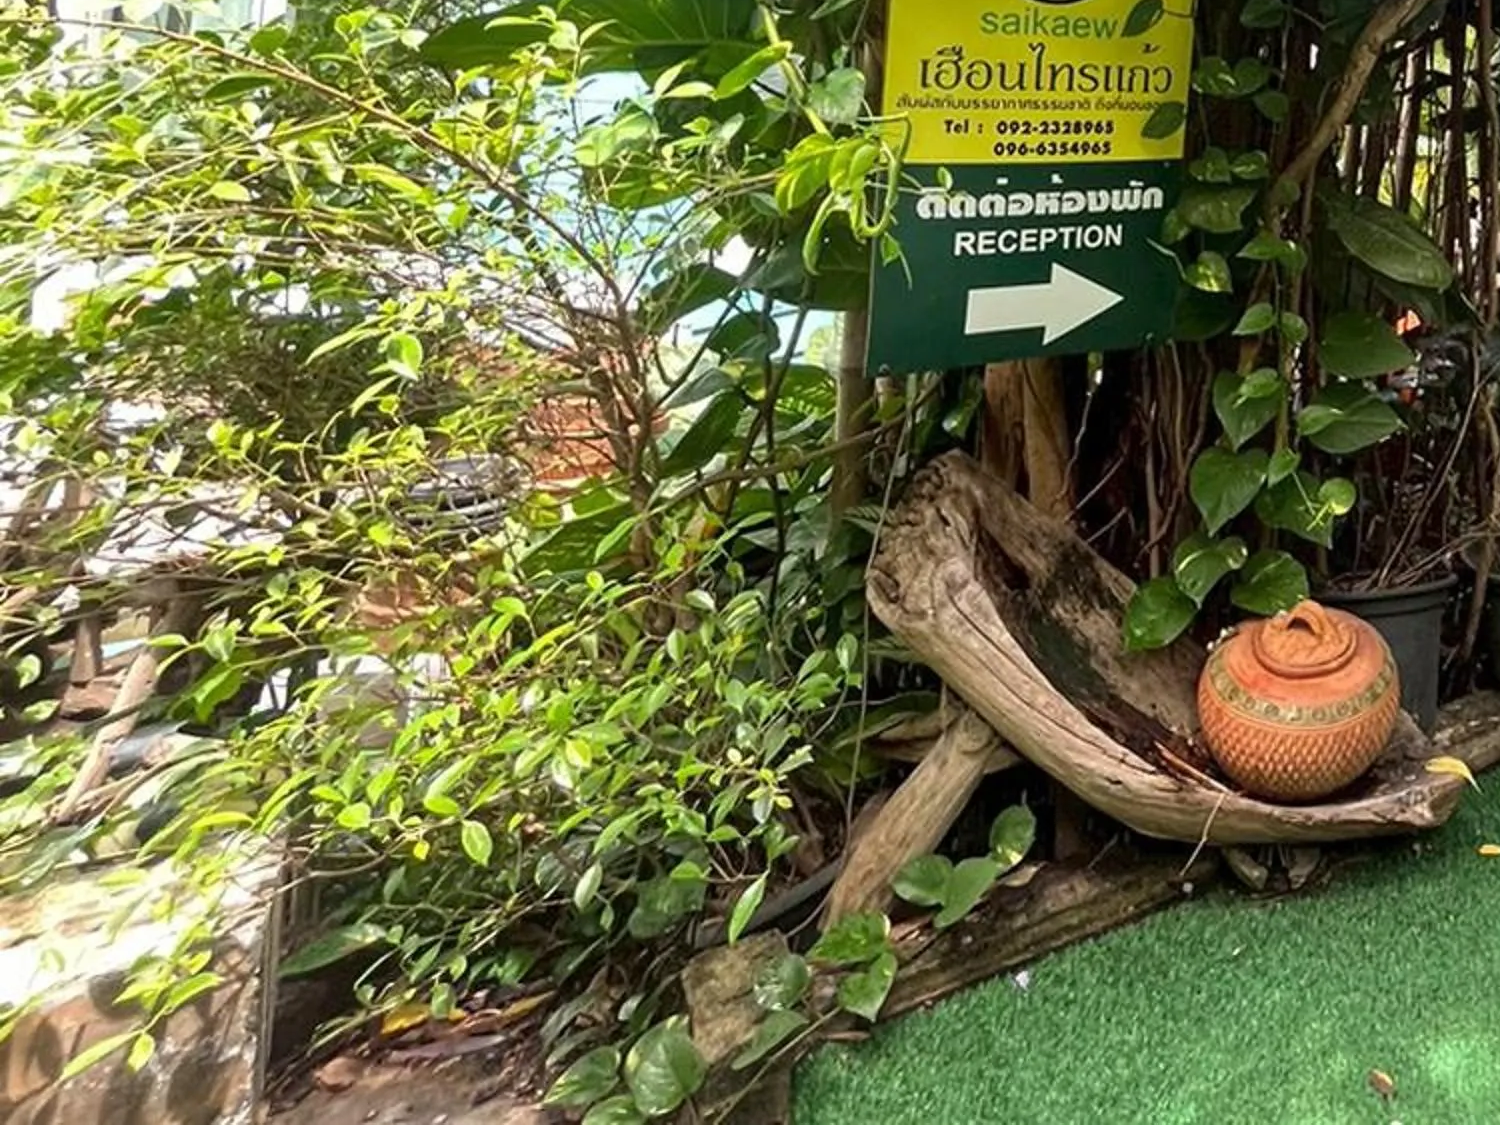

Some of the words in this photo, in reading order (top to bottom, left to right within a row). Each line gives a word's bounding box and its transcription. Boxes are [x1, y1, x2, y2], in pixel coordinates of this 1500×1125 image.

[980, 7, 1118, 39] saikaew
[919, 42, 1173, 95] เฮือนไทรแก้ว
[944, 119, 969, 134] Tel
[993, 141, 1111, 156] 096-6354965
[953, 224, 1123, 256] RECEPTION
